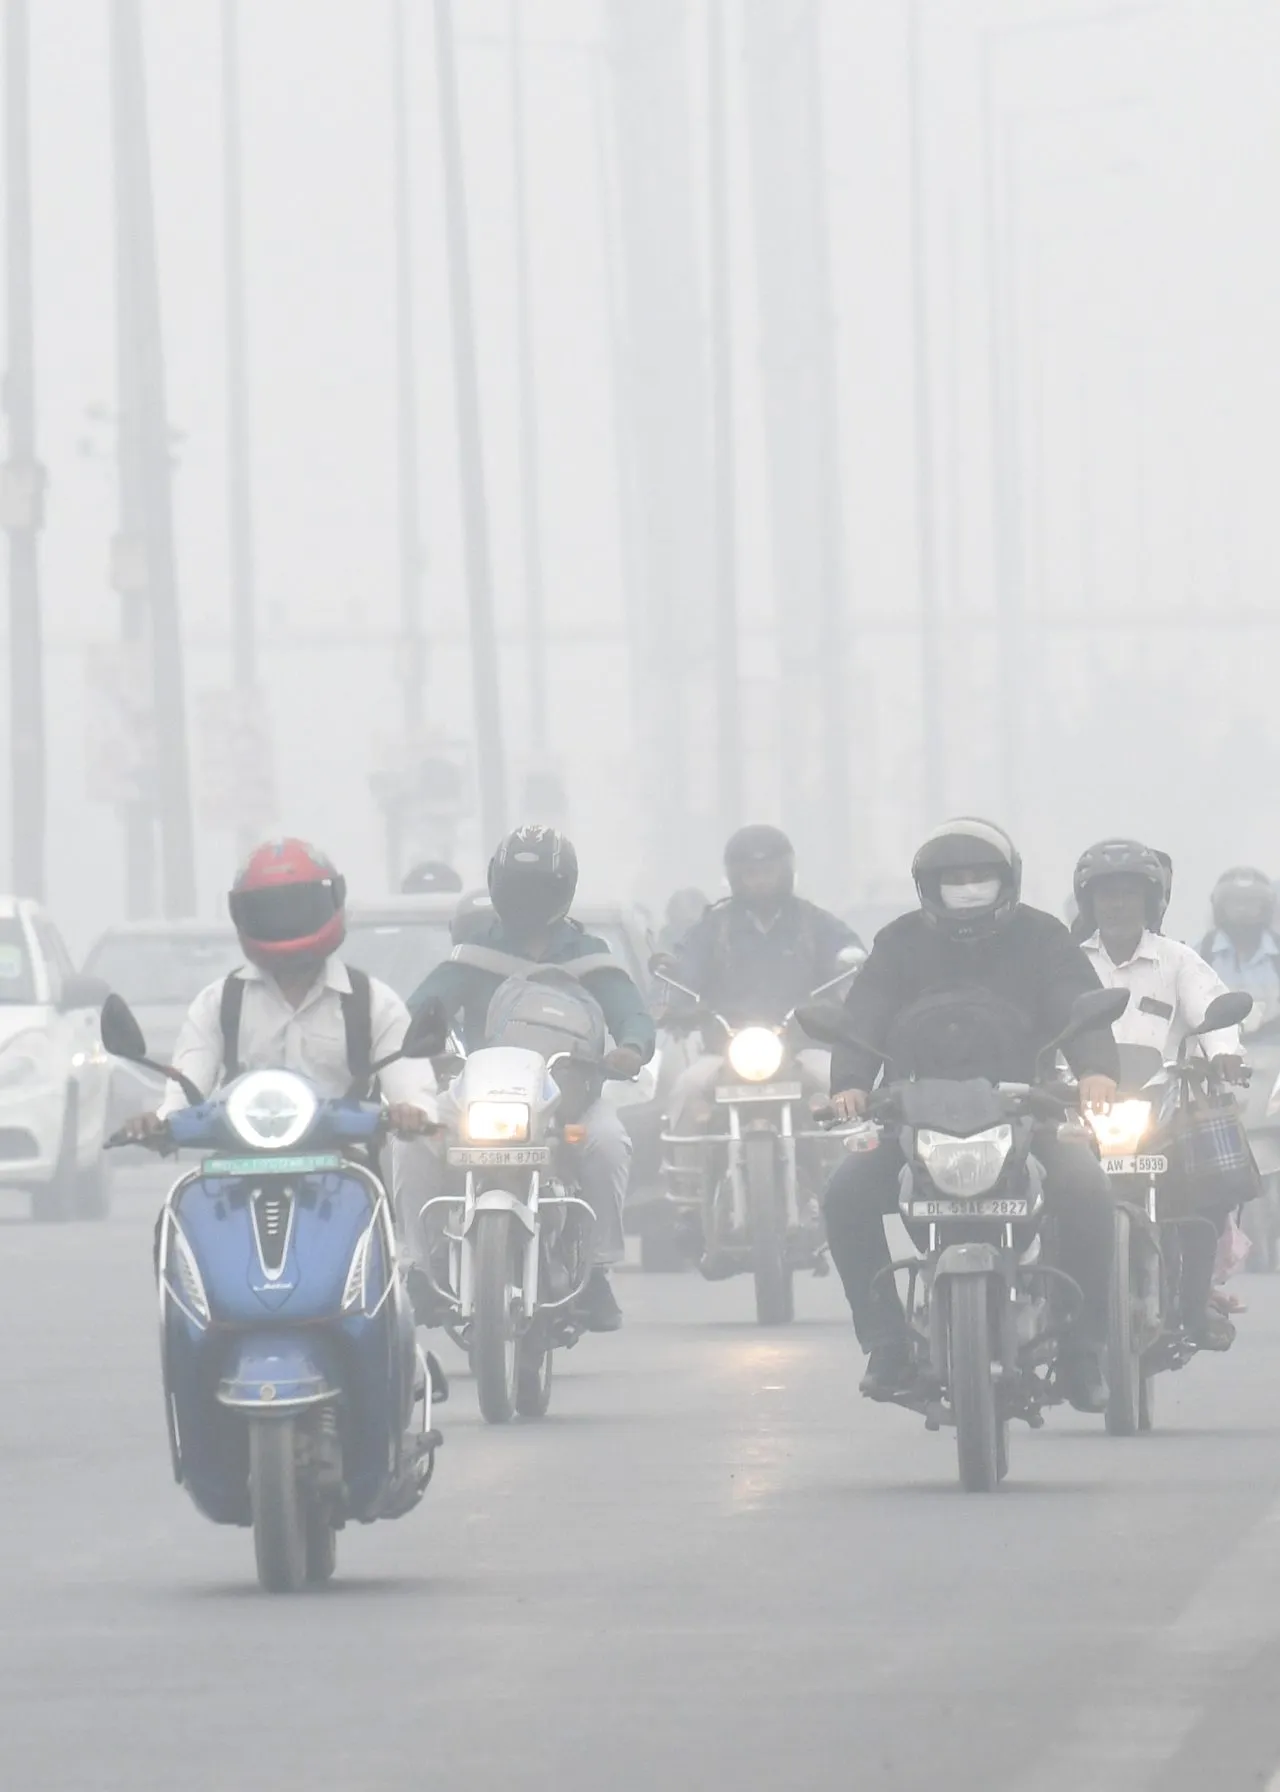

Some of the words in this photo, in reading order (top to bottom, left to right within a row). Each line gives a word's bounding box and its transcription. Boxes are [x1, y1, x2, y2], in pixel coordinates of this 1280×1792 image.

[1107, 1160, 1124, 1172] AW
[1140, 1158, 1164, 1171] 5939
[927, 1202, 943, 1214] DL
[992, 1201, 1026, 1214] 2827
